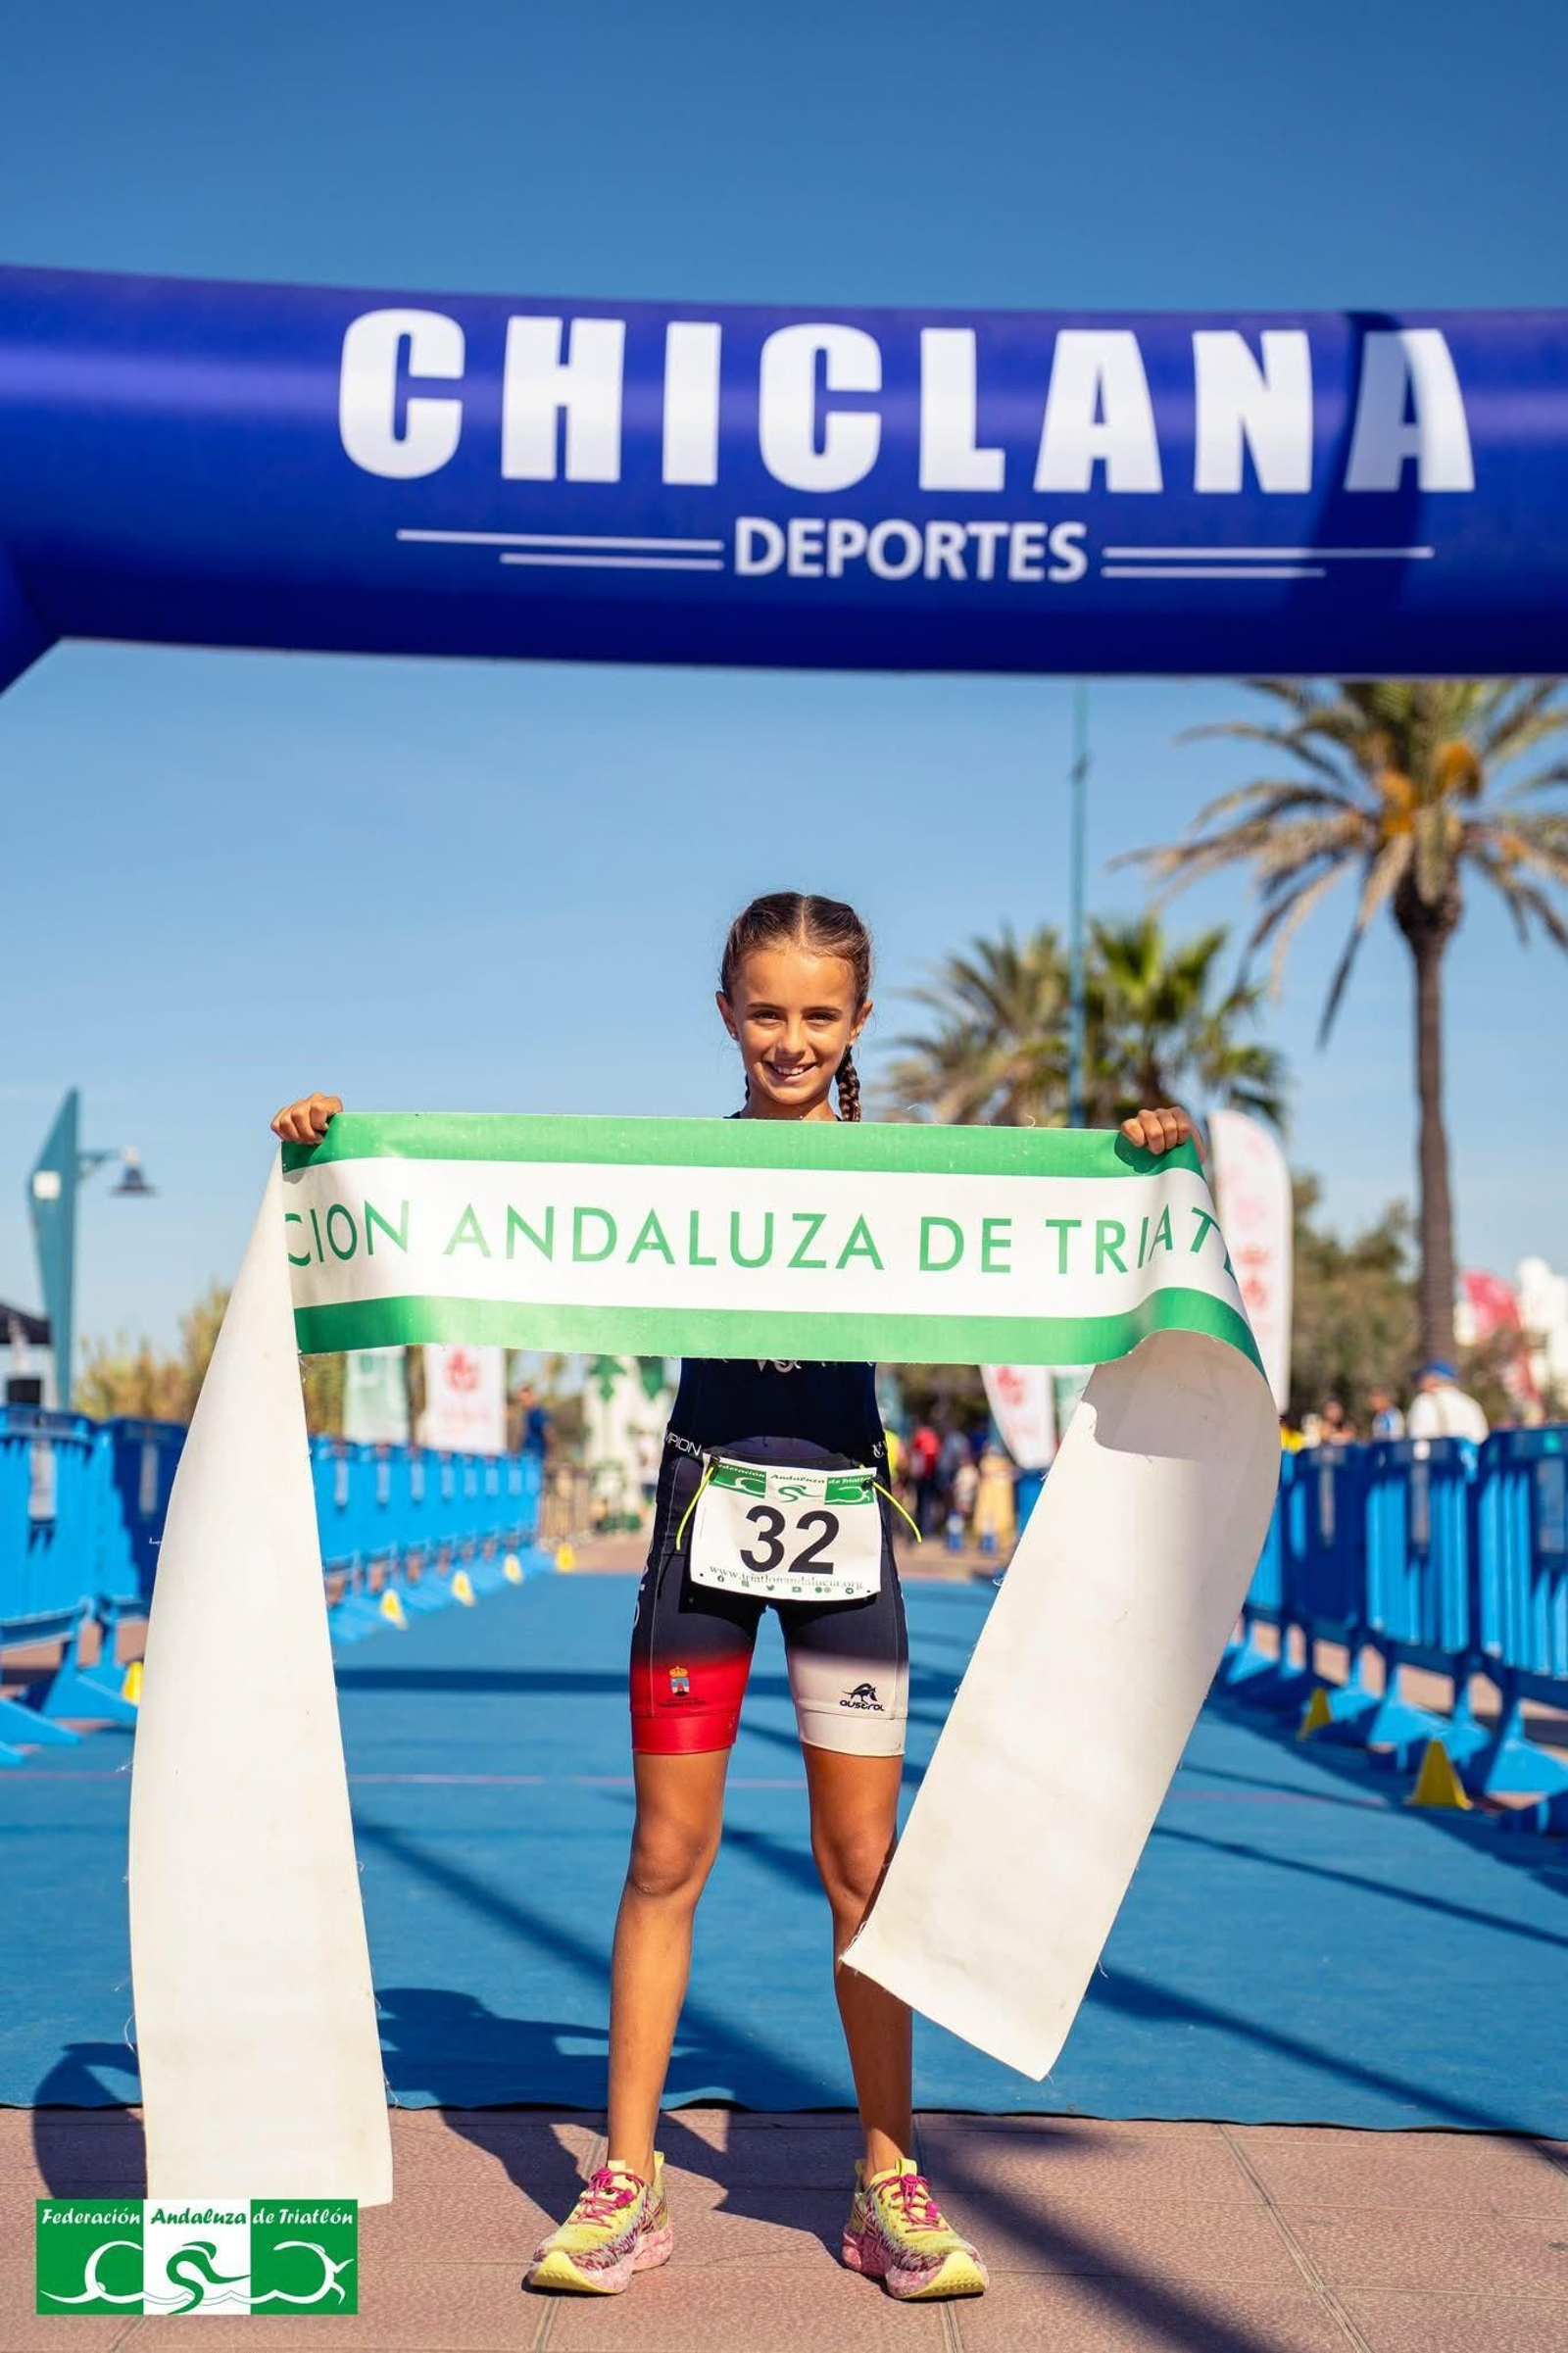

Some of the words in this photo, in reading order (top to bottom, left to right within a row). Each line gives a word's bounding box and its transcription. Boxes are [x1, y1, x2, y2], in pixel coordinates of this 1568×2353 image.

[339, 309, 1475, 494] CHICLANA
[735, 516, 1087, 583] DEPORTES
[444, 1203, 884, 1271] ANDALUZA
[919, 1216, 1013, 1274] DE
[740, 1505, 840, 1575] 32
